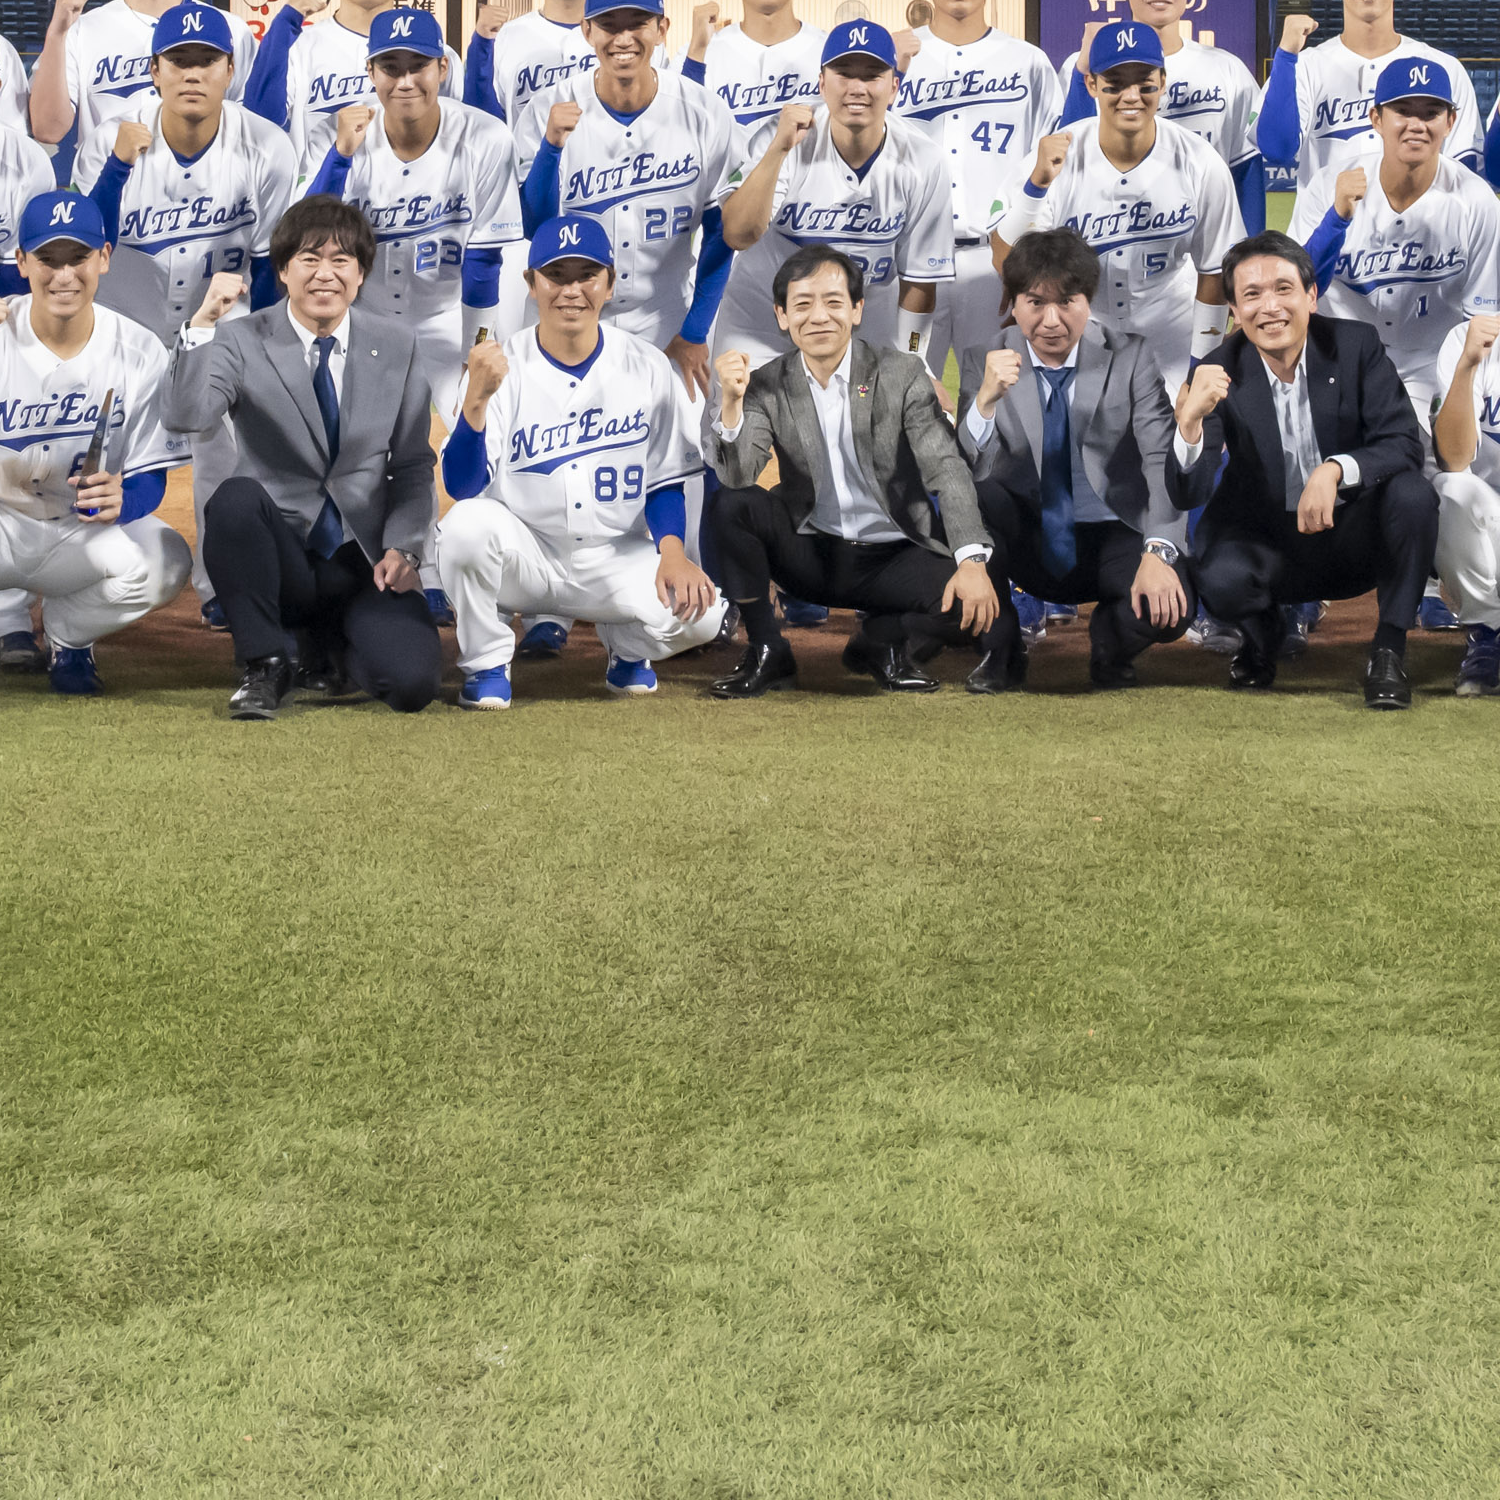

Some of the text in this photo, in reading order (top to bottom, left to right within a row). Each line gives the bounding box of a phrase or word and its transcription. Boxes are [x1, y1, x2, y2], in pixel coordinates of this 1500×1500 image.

[971, 121, 1015, 156] 47
[644, 205, 692, 240] 22
[202, 248, 244, 278] 13
[415, 240, 462, 273] 23
[595, 466, 644, 501] 89
